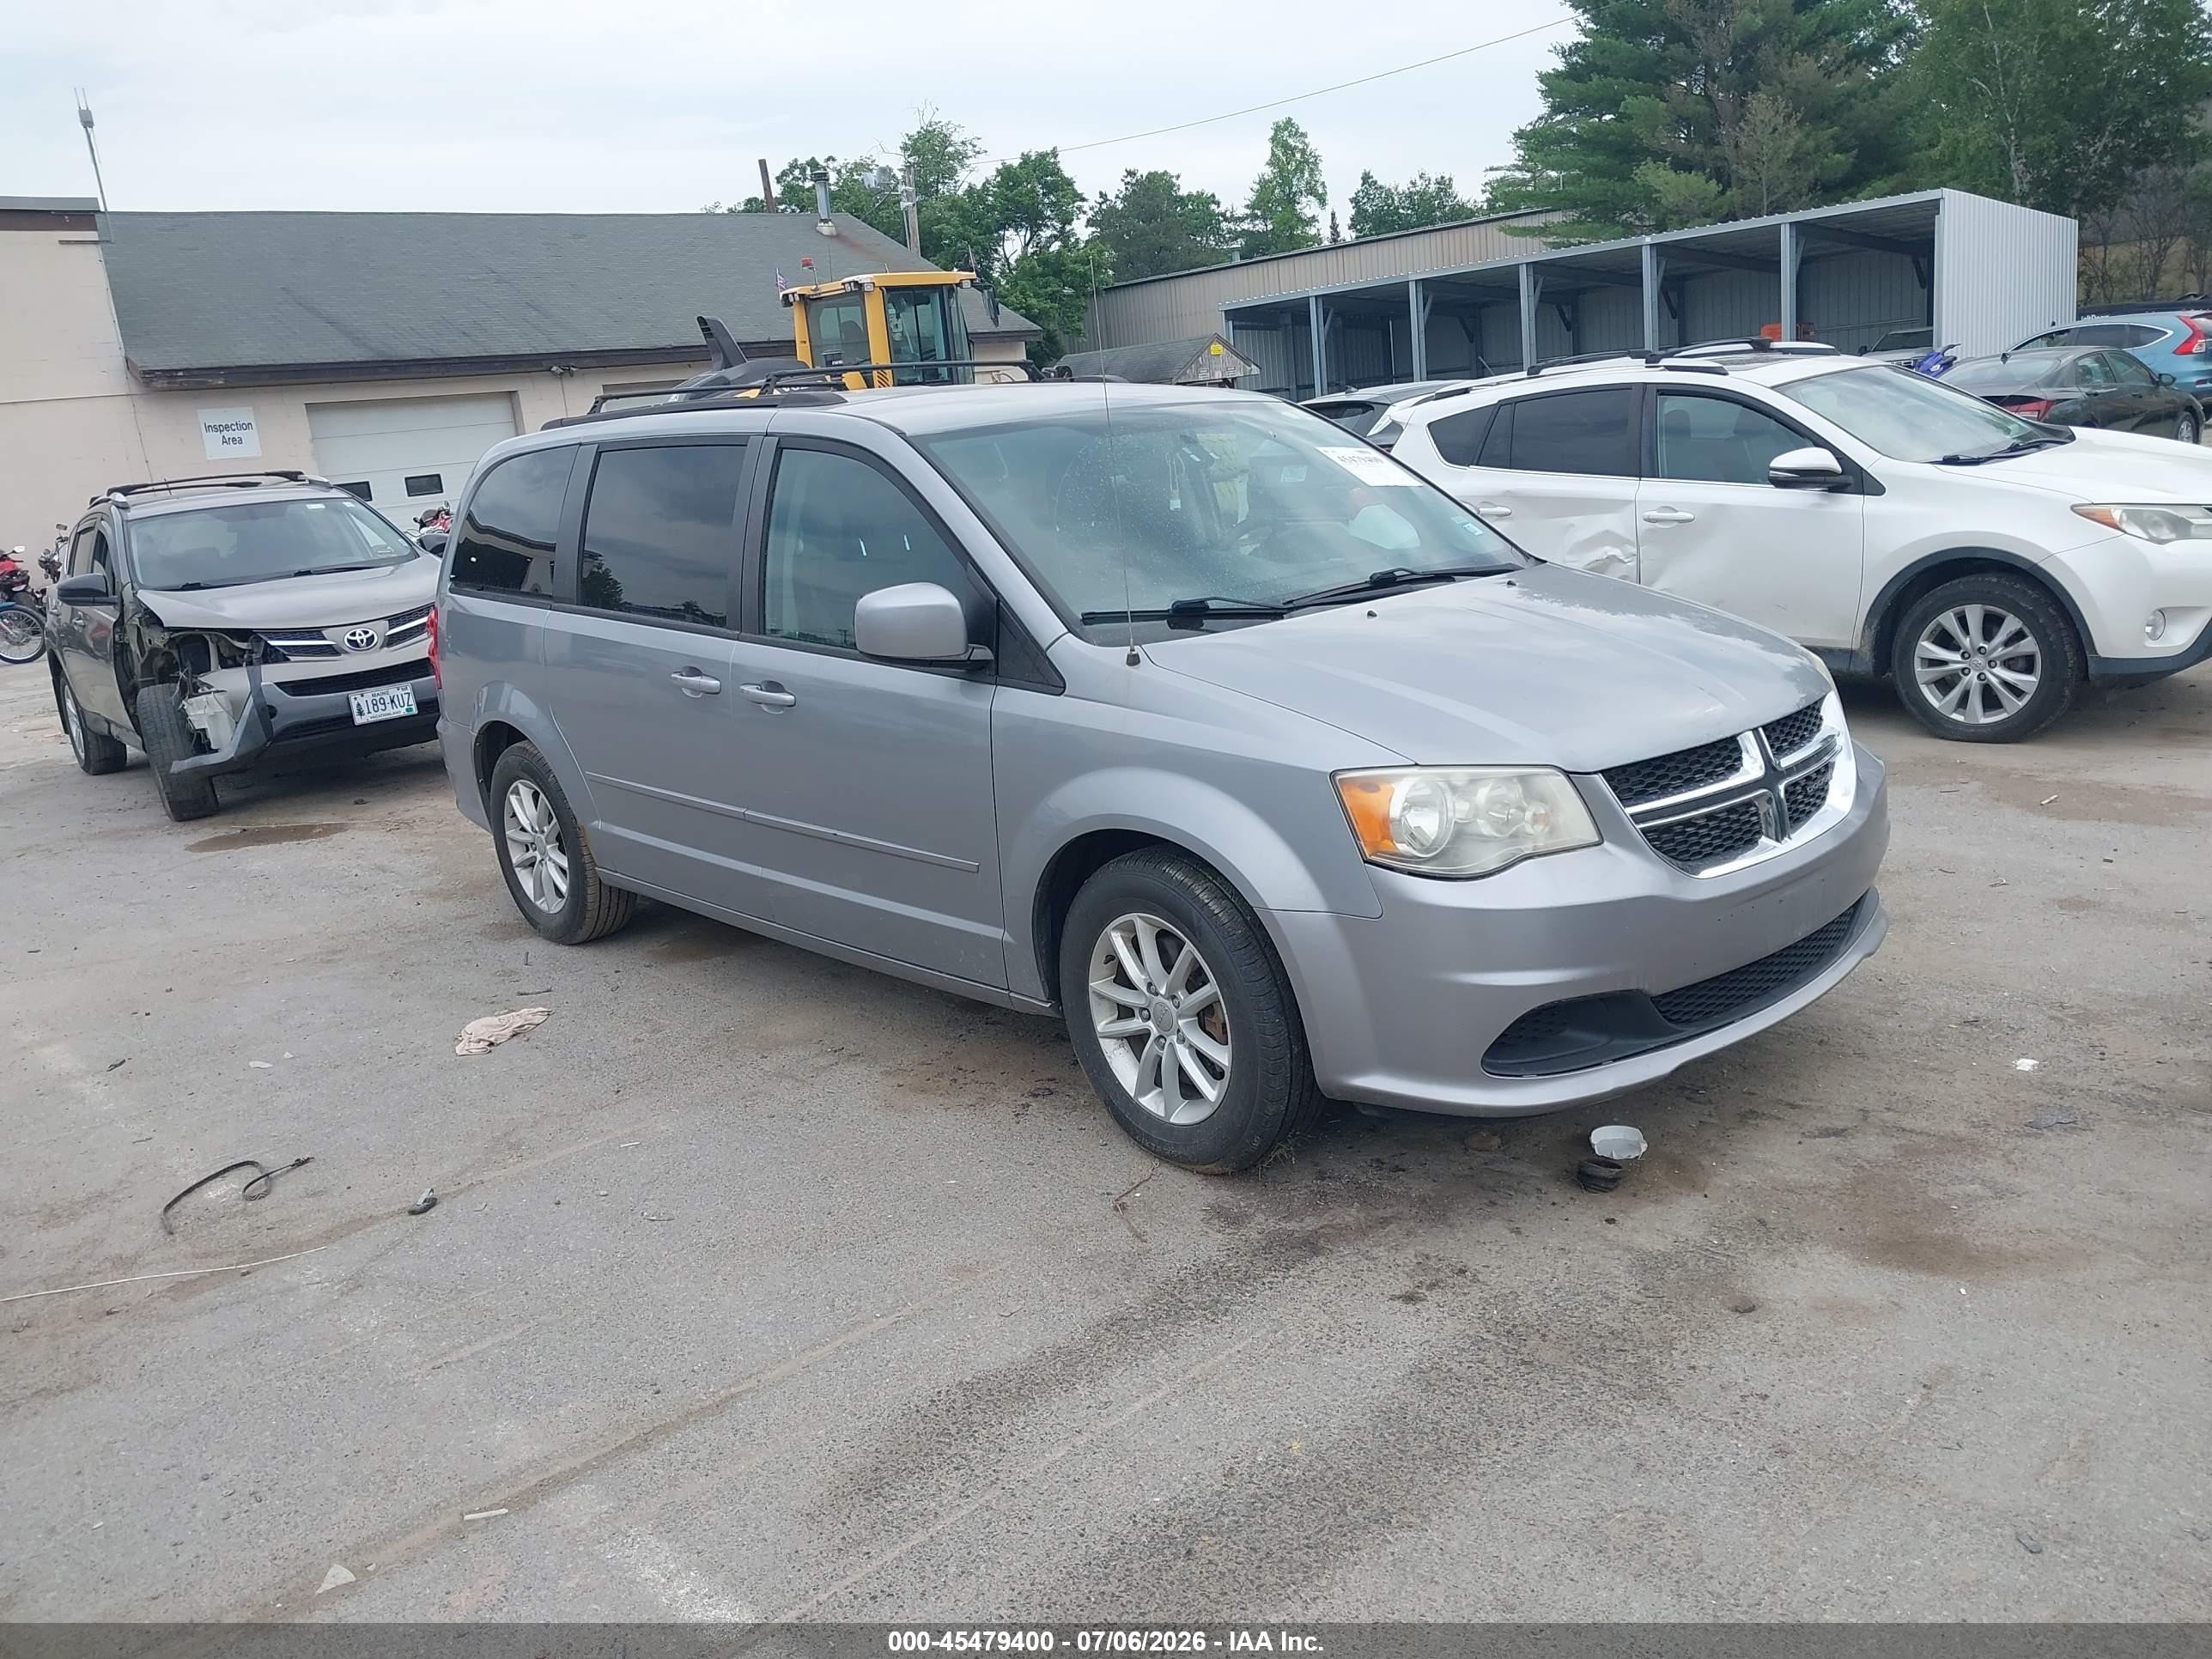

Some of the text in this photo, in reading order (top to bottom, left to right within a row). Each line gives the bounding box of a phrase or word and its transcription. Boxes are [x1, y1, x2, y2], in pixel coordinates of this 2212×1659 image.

[204, 421, 253, 434] Inspection
[222, 434, 243, 446] Area
[365, 692, 413, 714] 189-KUZ
